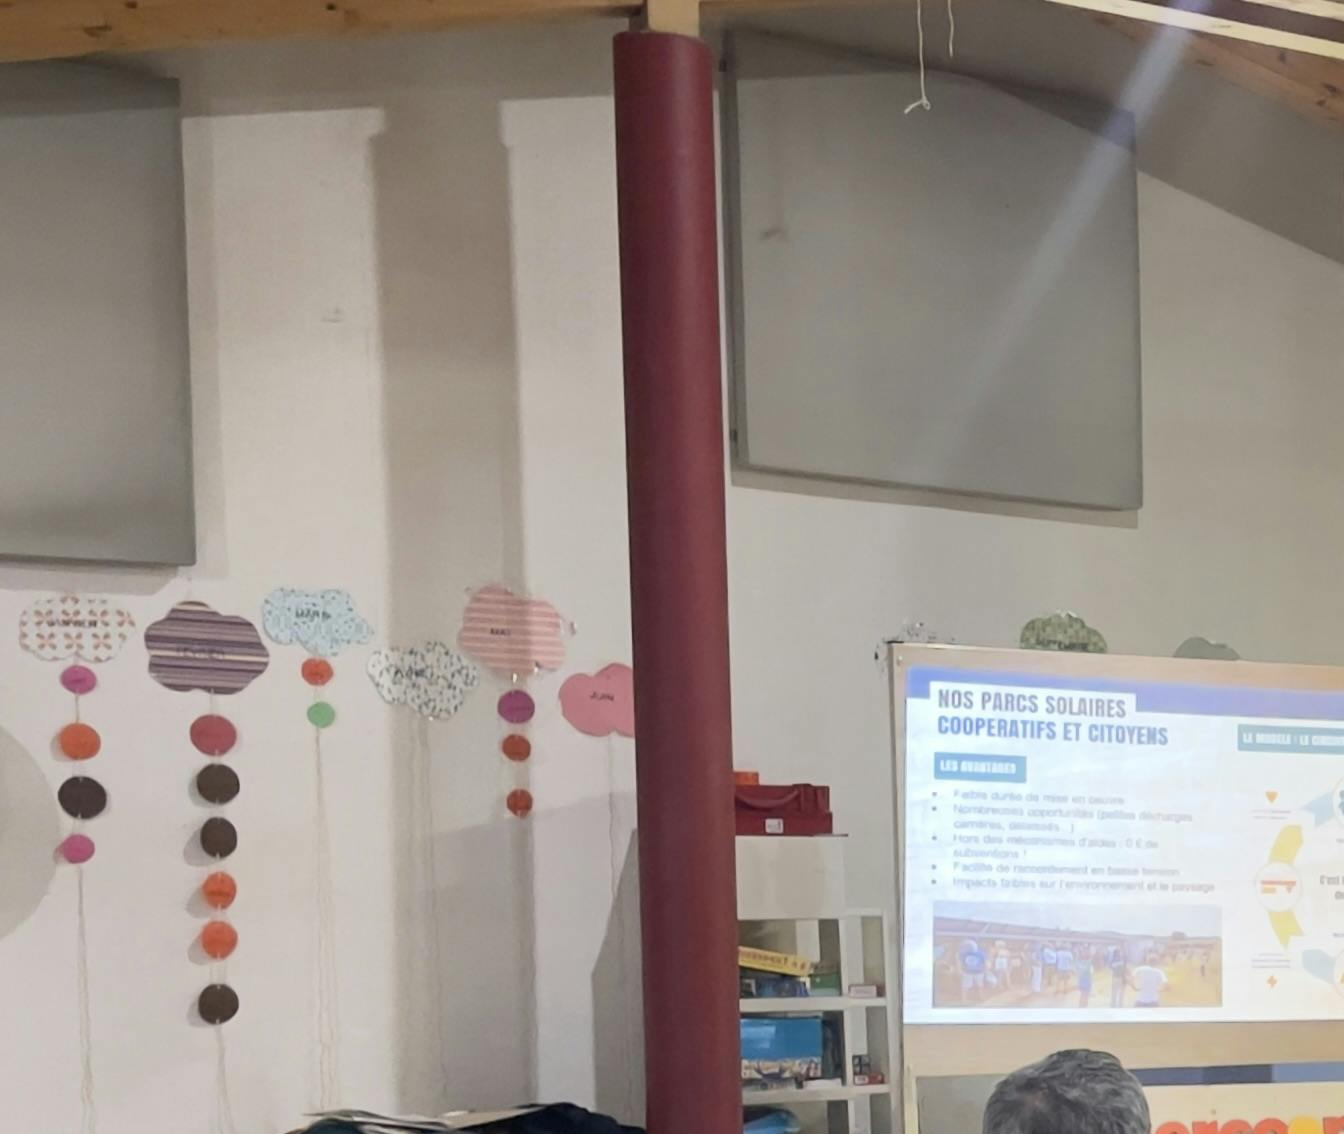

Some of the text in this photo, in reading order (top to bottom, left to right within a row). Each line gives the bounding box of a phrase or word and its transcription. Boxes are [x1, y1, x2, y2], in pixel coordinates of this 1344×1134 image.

[938, 689, 1126, 718] NOS PARCS SOLAIRES
[1063, 723, 1082, 742] ET
[1087, 724, 1169, 746] CITOYENS
